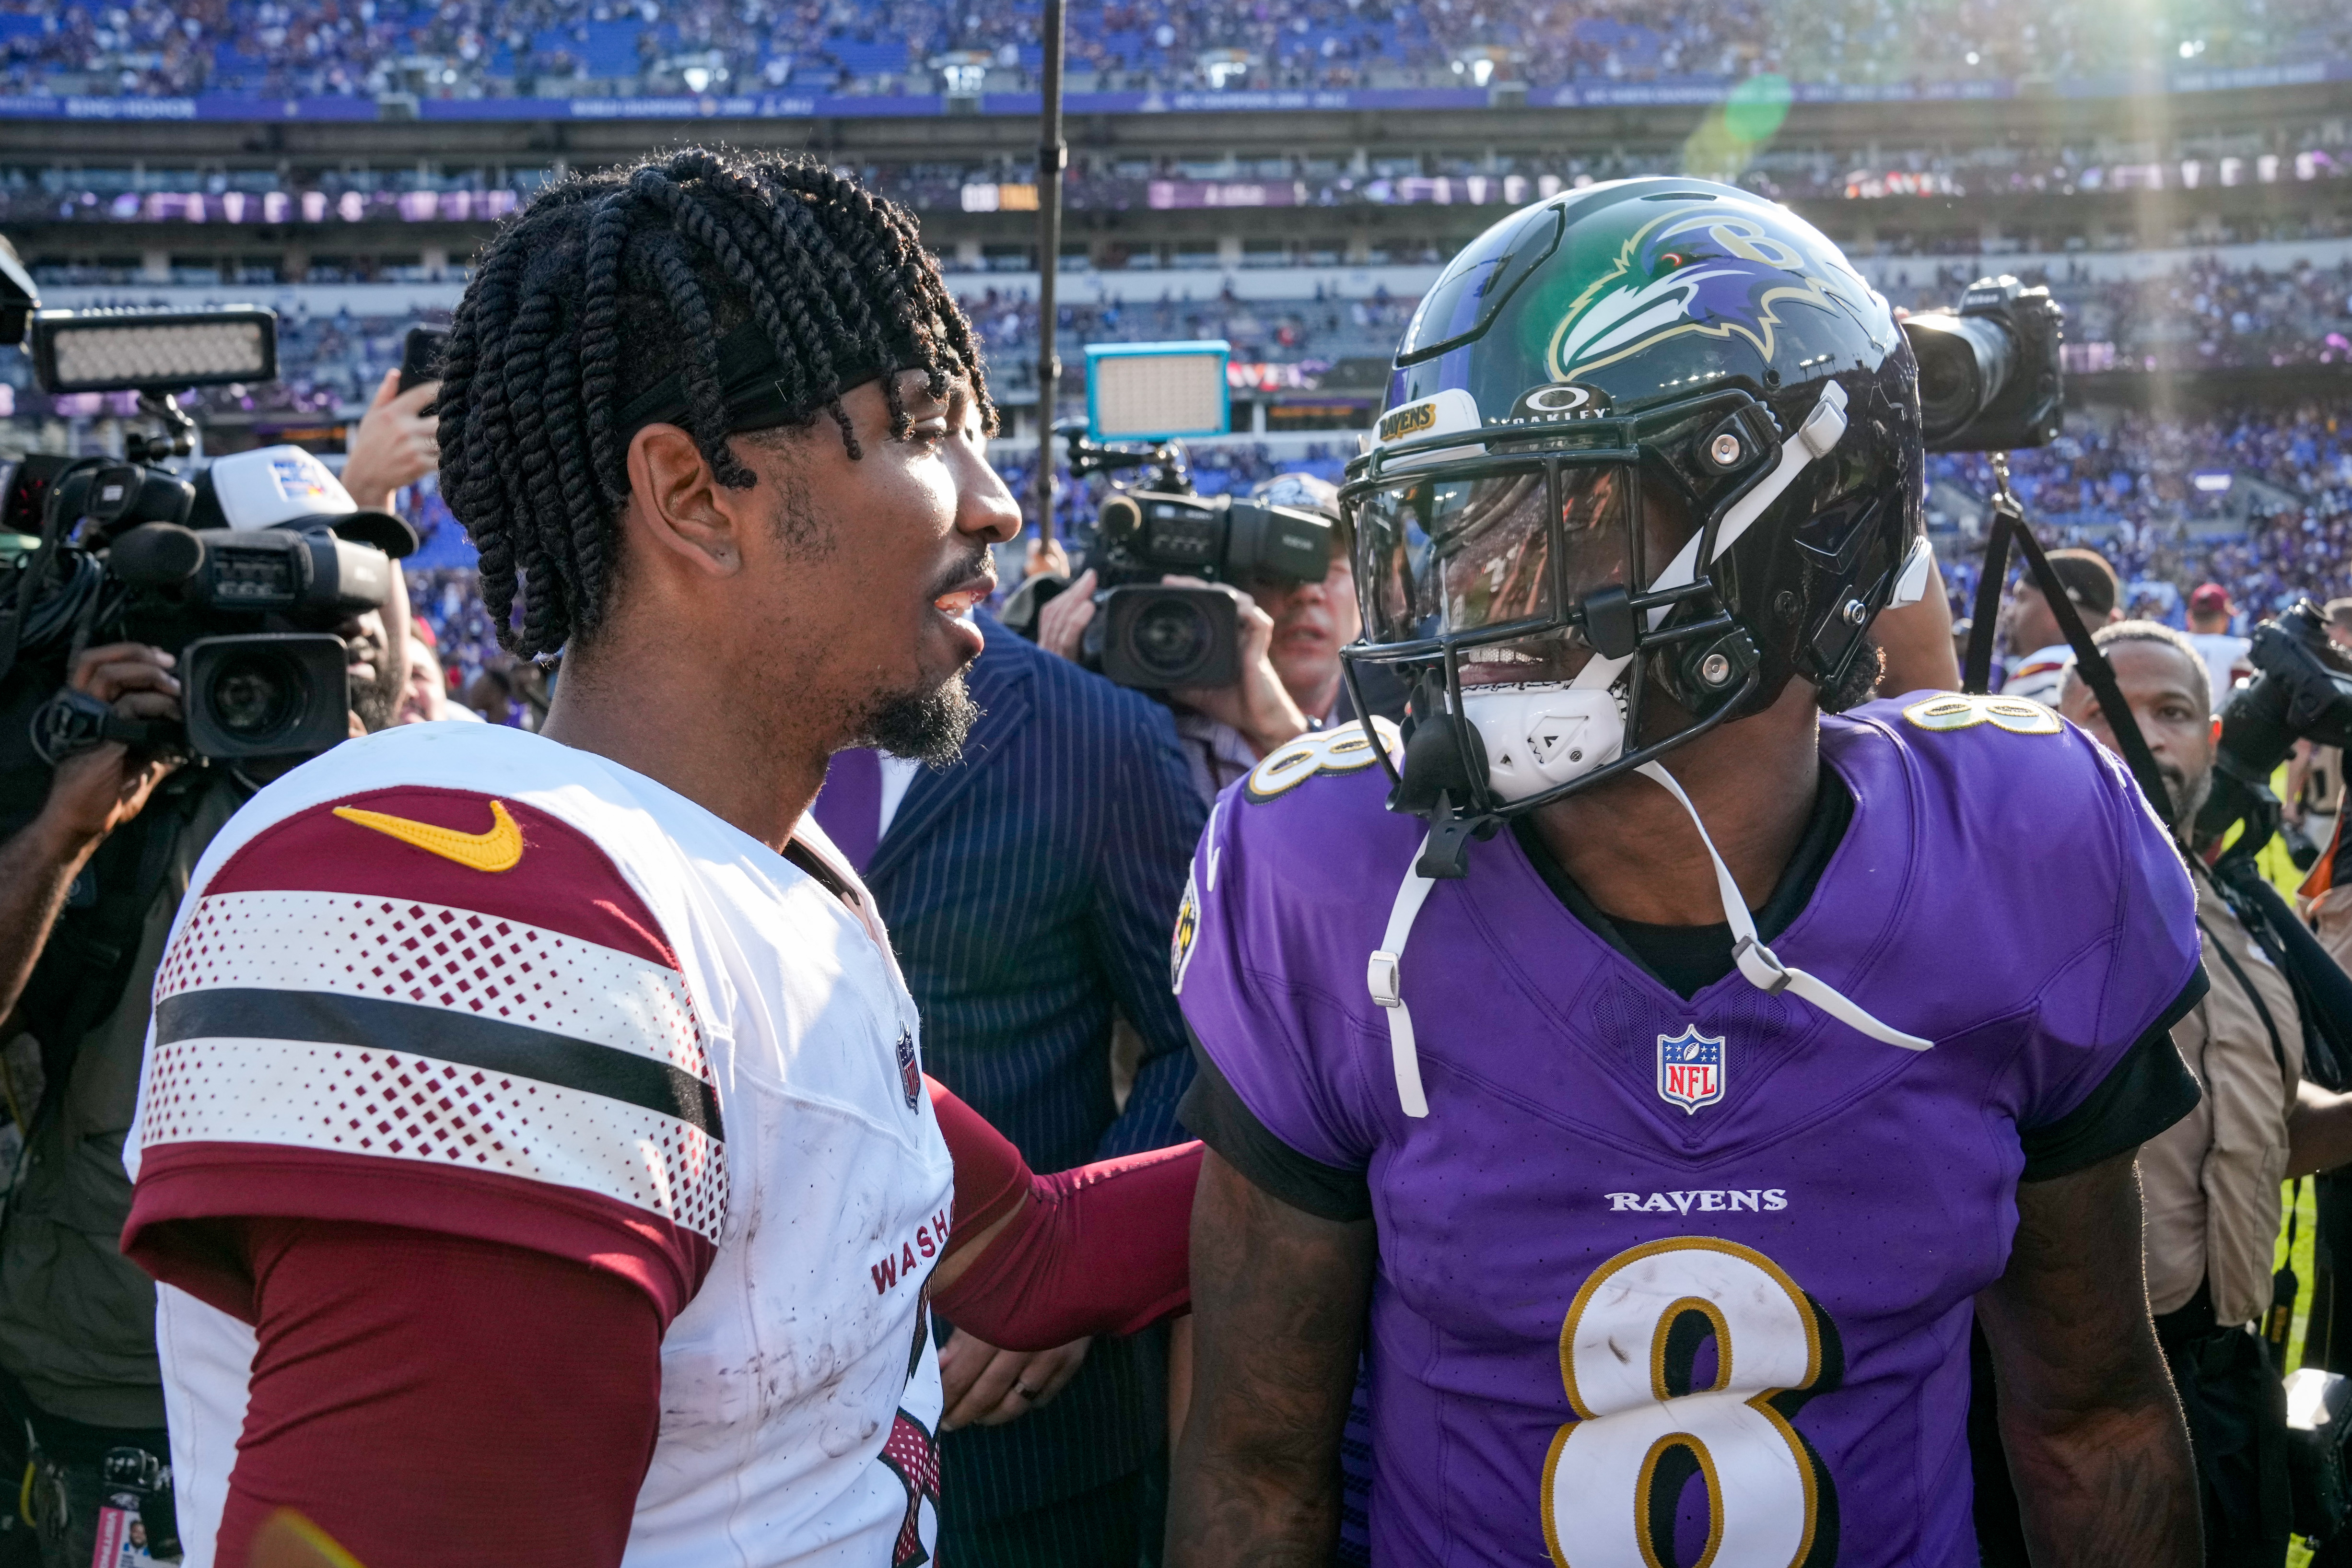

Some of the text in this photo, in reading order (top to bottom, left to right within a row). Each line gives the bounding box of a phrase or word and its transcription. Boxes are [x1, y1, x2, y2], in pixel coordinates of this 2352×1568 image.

[1380, 403, 1436, 441] RAVENS
[1242, 727, 1394, 806] 8
[1669, 1065, 1715, 1099] NFL
[1604, 1188, 1788, 1216] RAVENS
[1540, 1235, 1845, 1568] 8
